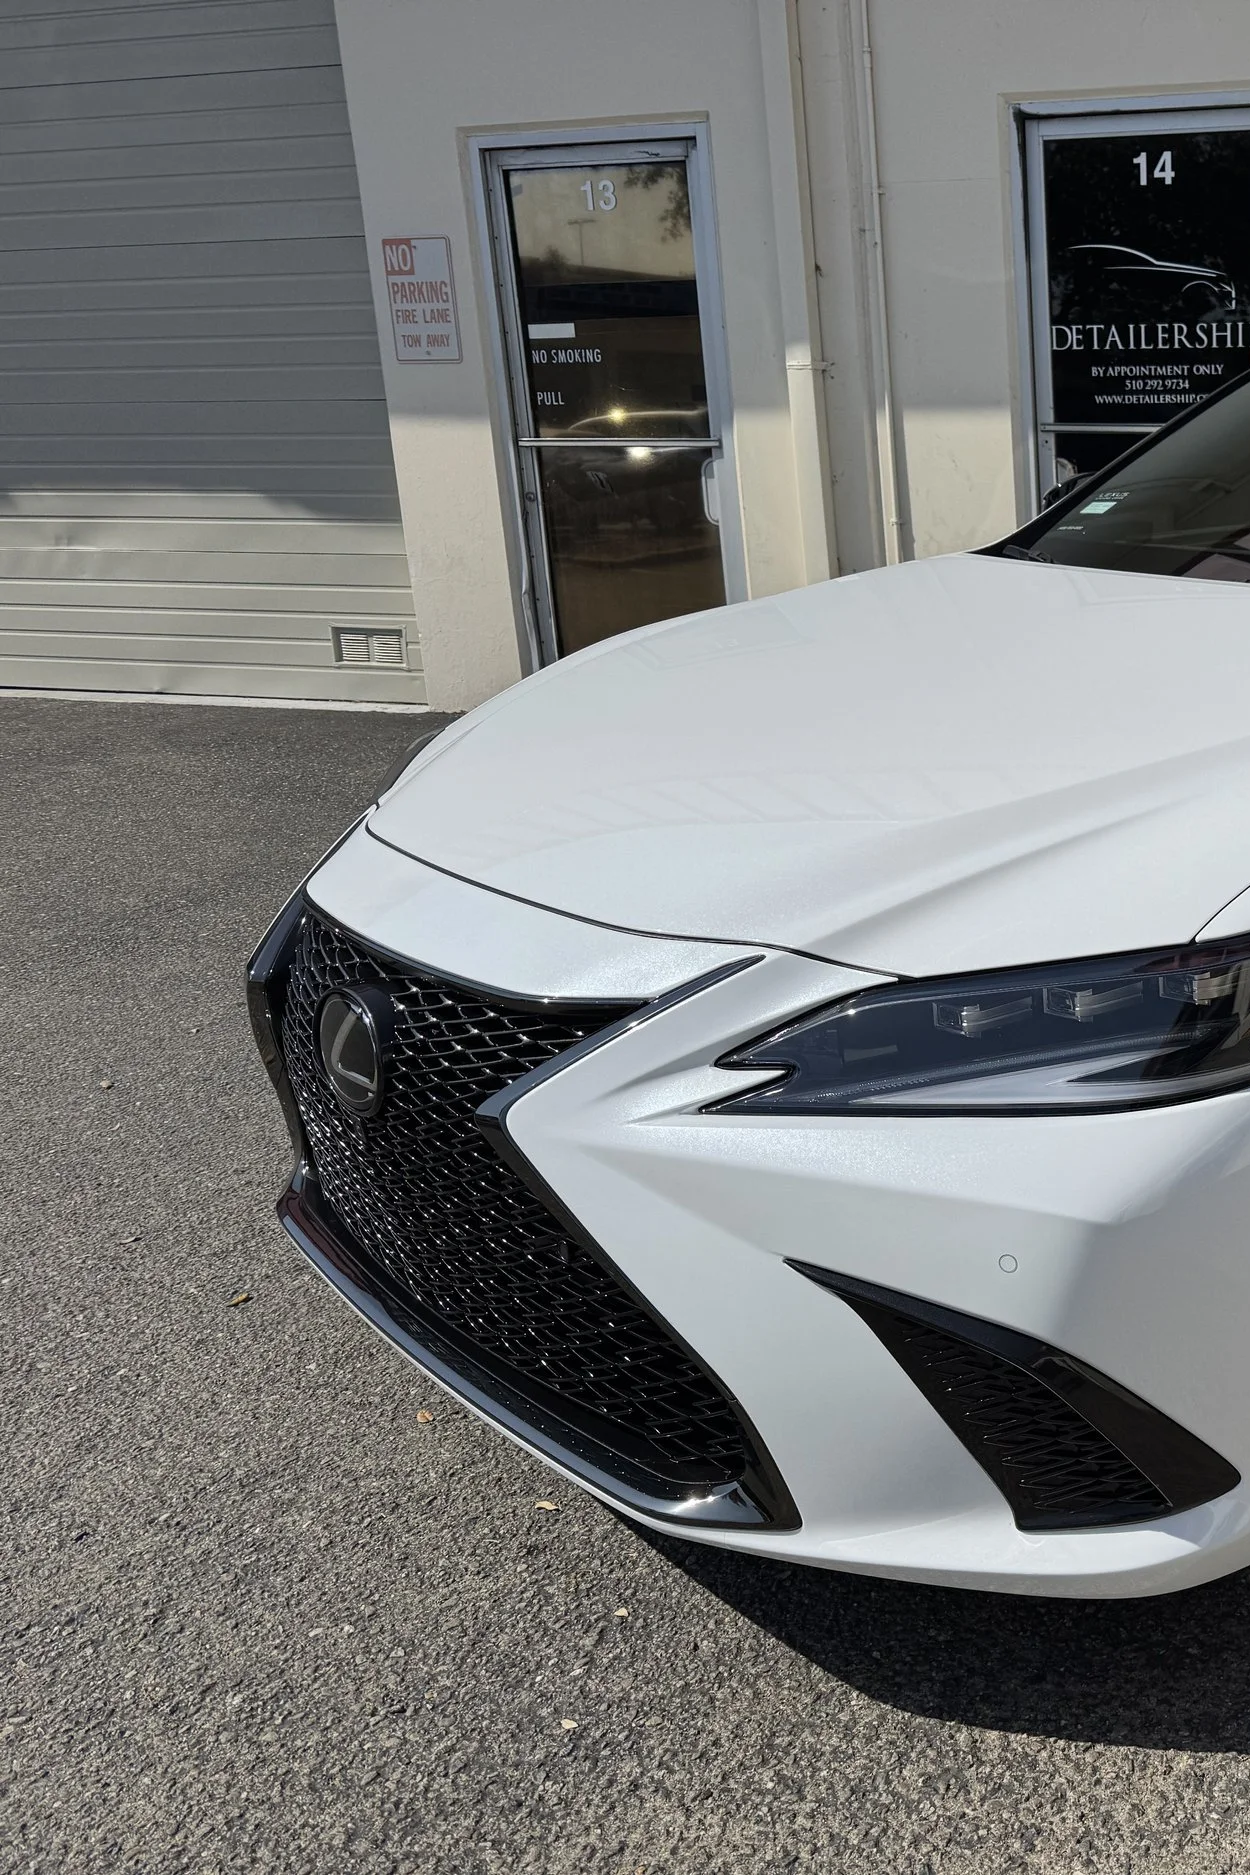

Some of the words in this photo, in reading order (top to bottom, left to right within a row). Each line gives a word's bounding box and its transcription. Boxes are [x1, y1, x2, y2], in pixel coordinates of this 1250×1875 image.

[1132, 150, 1176, 186] 14
[580, 179, 617, 211] 13
[384, 244, 411, 271] NO
[391, 281, 450, 304] PARKING
[395, 309, 418, 324] FIRE
[422, 308, 452, 323] LANE
[401, 334, 422, 348] TOW
[426, 334, 451, 348] AWAY
[532, 350, 547, 363] NO
[551, 348, 602, 363] SMOKING
[1091, 366, 1105, 377] BY
[1107, 365, 1190, 377] APPOINTMENT
[1192, 364, 1224, 375] ONLY
[1125, 380, 1144, 390] 510
[1144, 380, 1164, 390] 292
[1166, 379, 1190, 390] 9734
[537, 391, 565, 405] PULL
